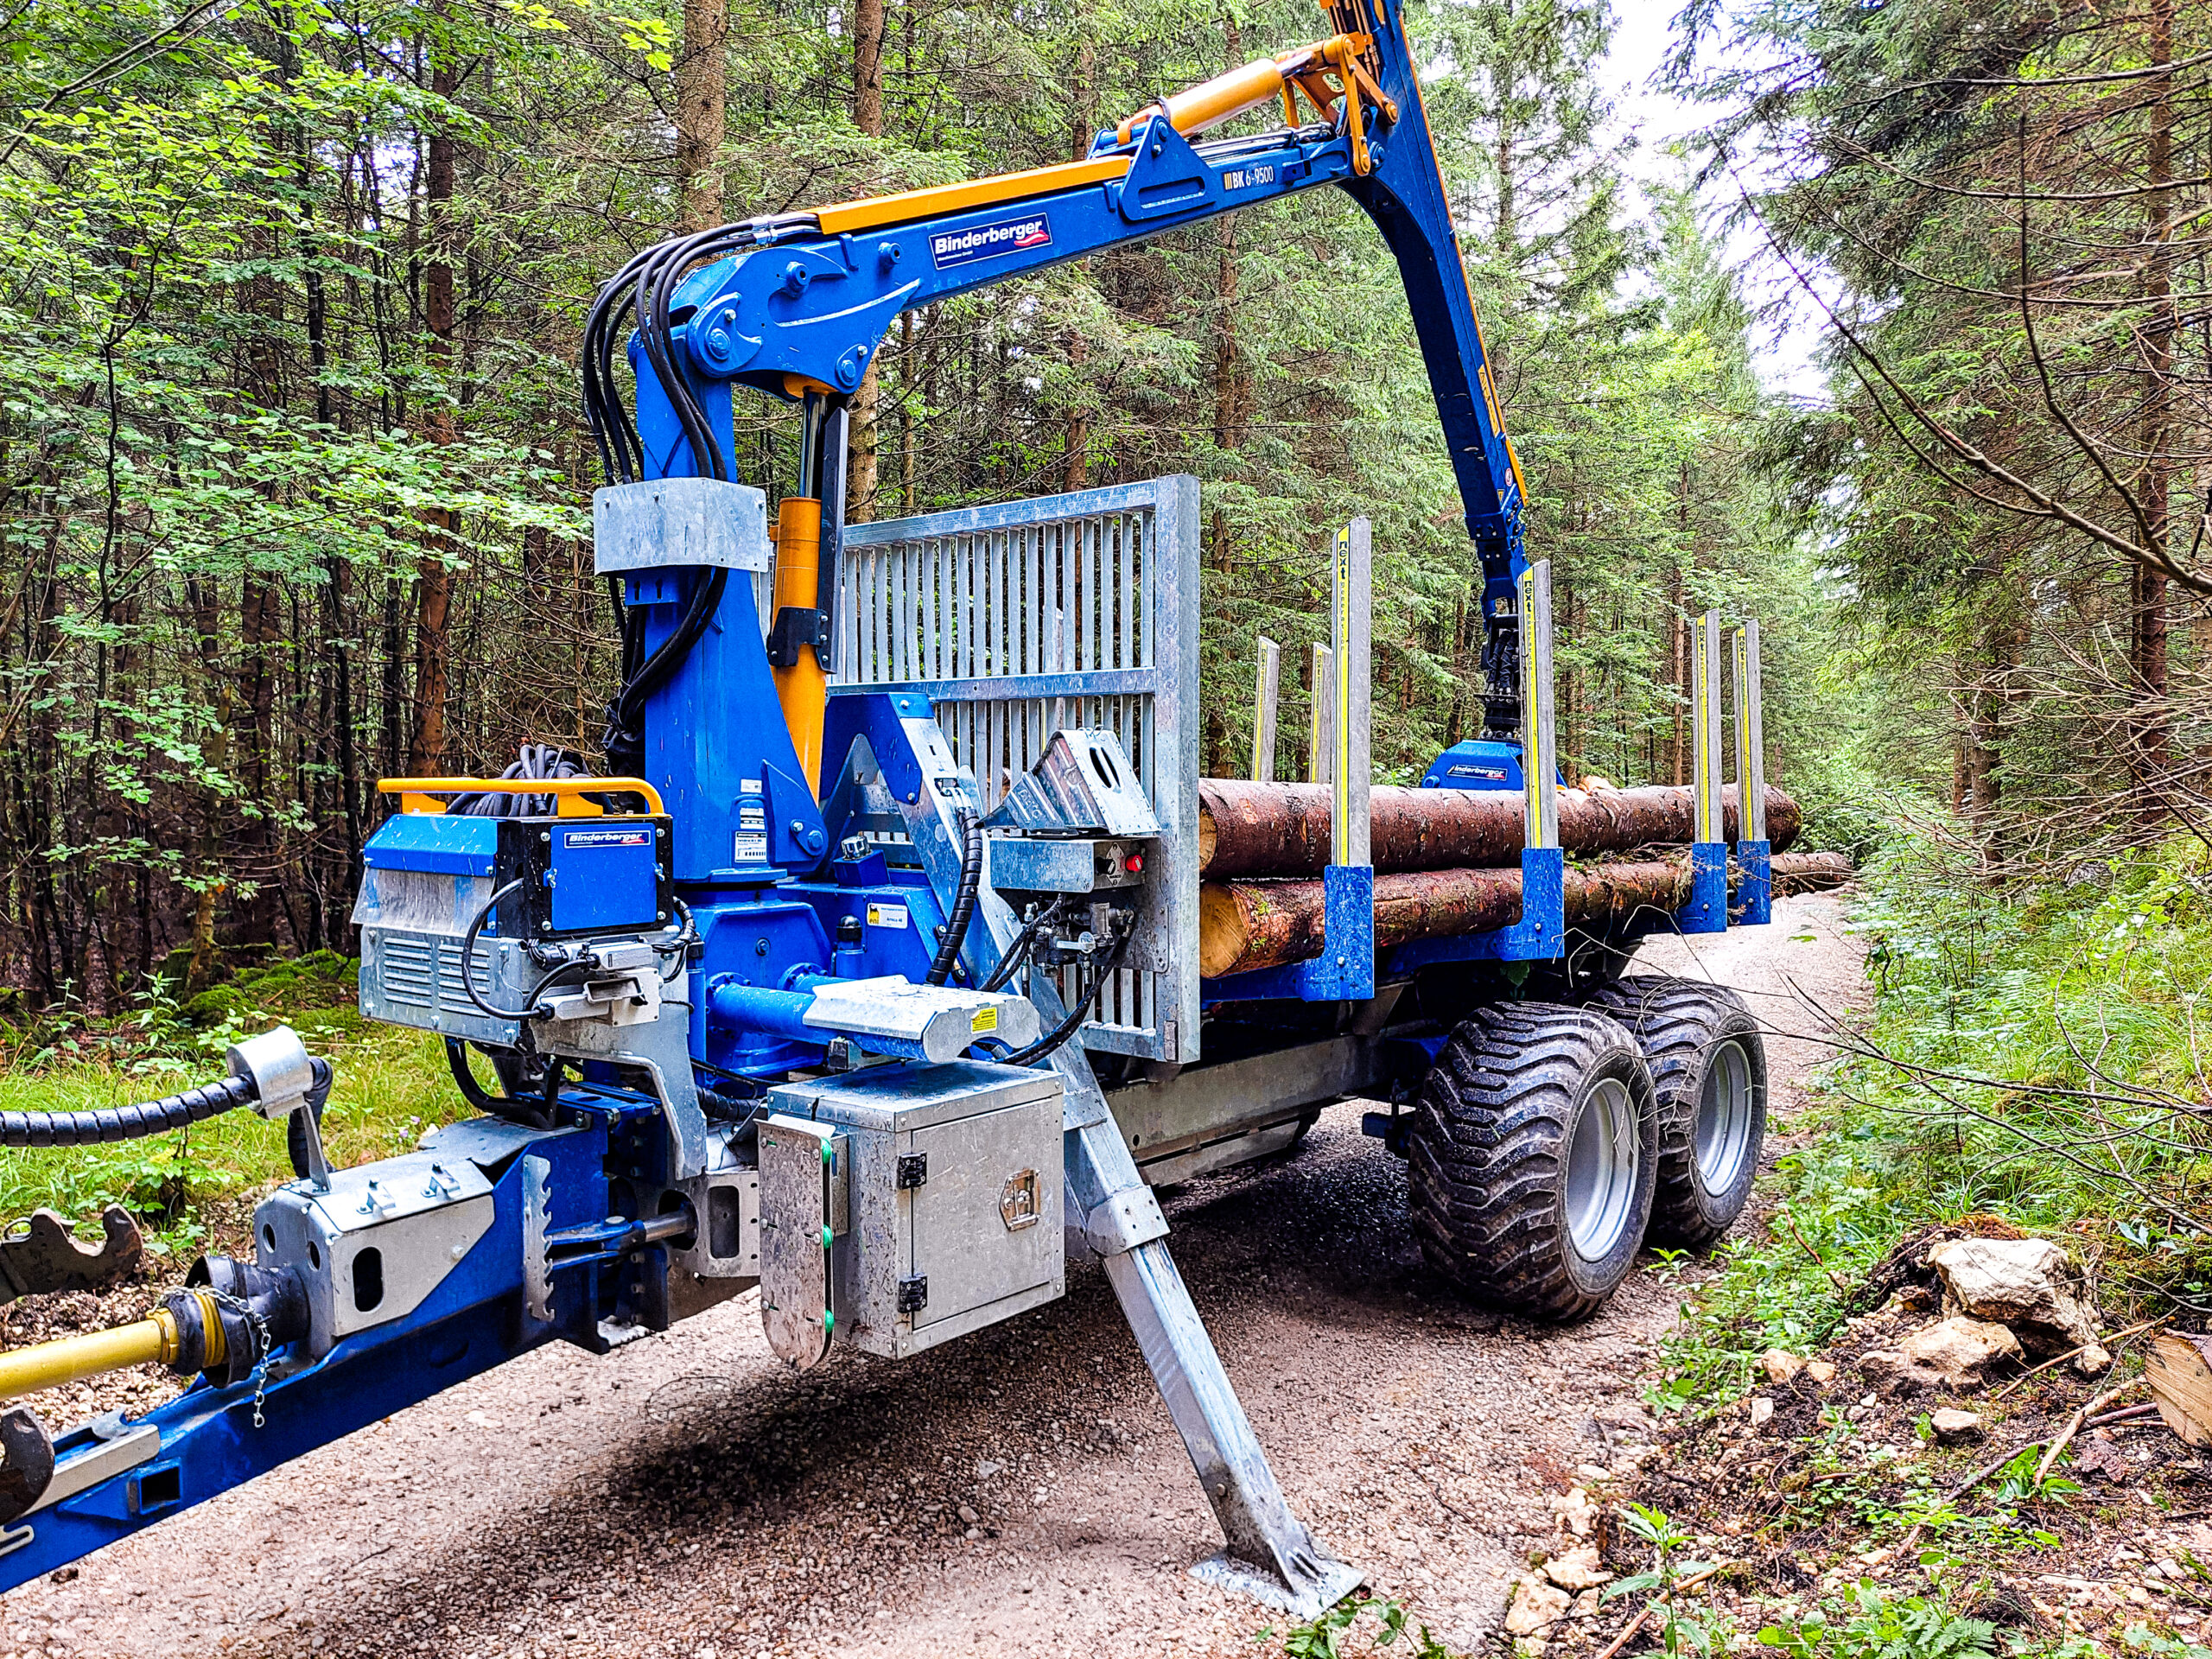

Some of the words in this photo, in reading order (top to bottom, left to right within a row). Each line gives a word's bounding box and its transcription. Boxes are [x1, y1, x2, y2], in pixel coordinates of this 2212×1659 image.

[1232, 173, 1245, 188] BK
[1246, 165, 1274, 187] 6-9500
[935, 220, 1043, 254] Binderberger
[1338, 540, 1348, 580] next
[1523, 580, 1533, 613] next
[1454, 765, 1504, 776] inderberger
[569, 833, 642, 842] Binderberger
